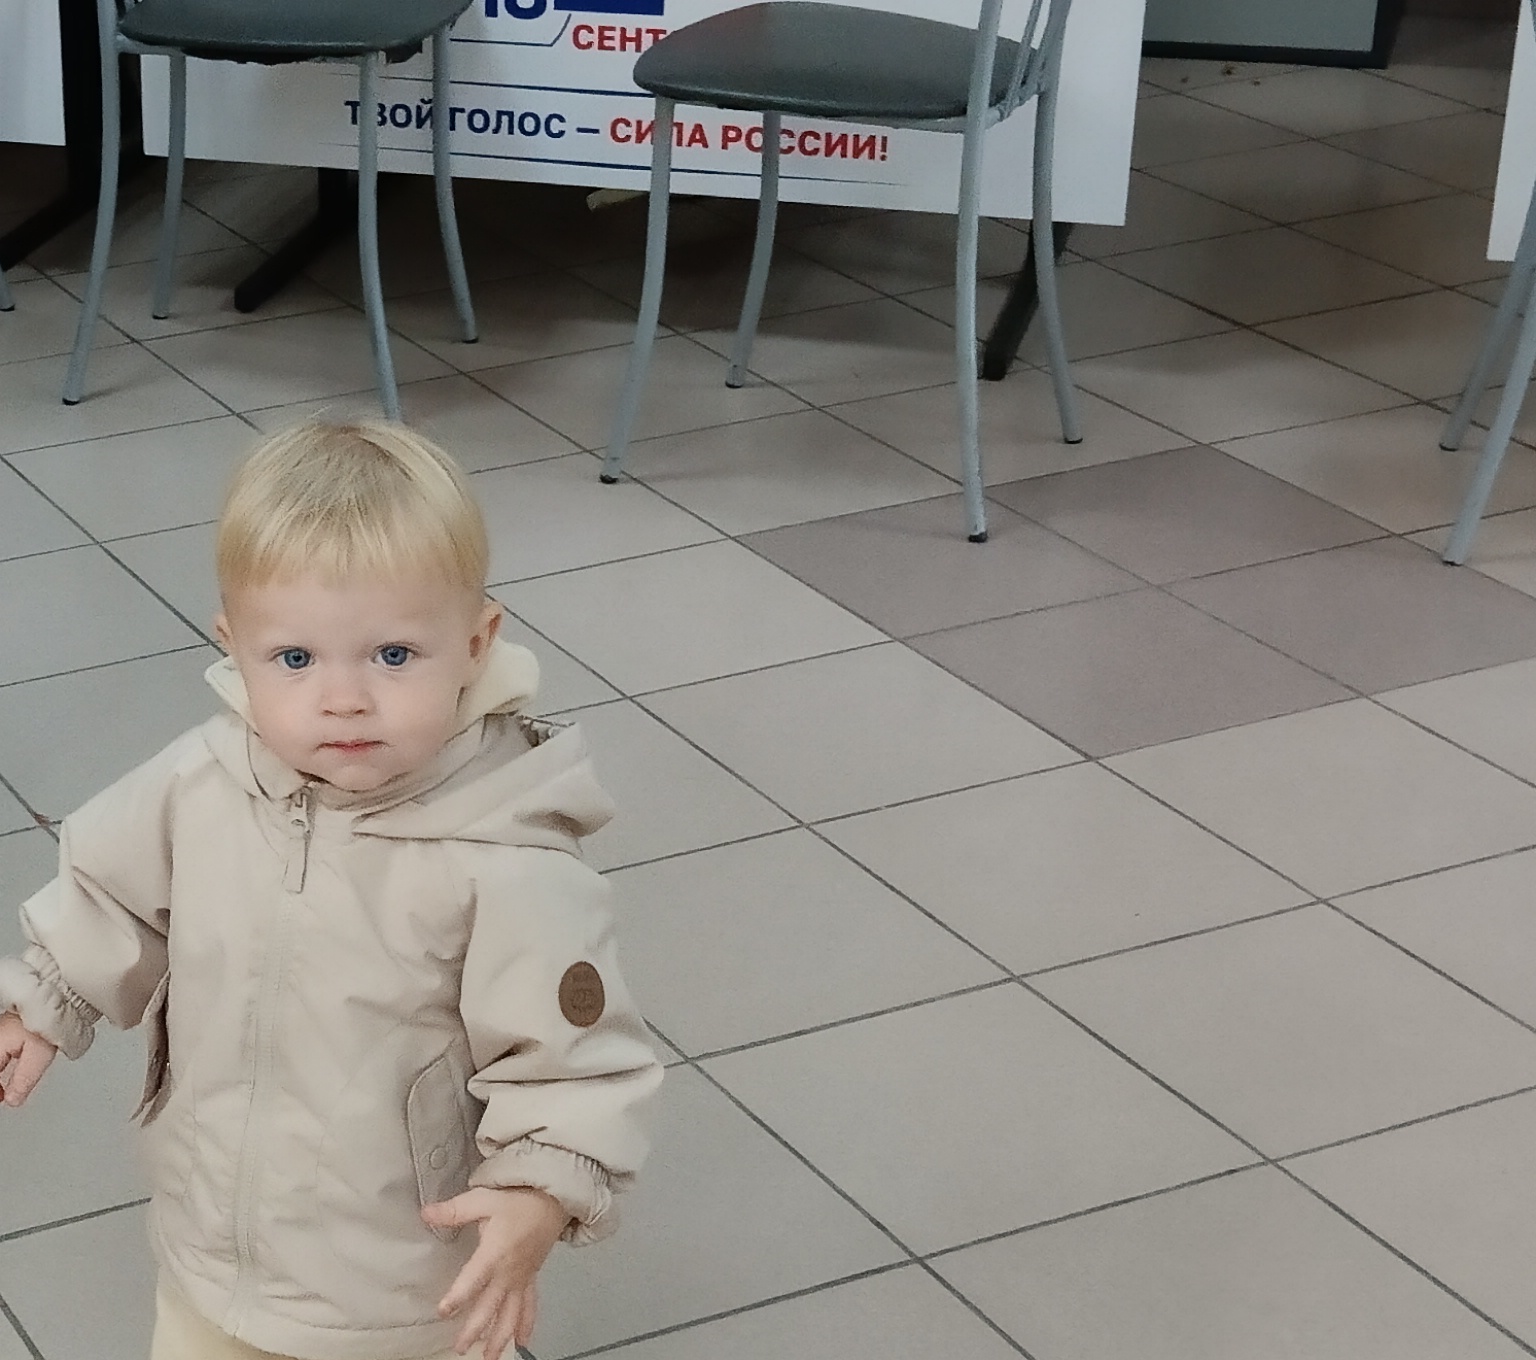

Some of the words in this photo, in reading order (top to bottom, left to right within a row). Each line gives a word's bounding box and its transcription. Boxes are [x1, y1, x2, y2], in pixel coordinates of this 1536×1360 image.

[571, 24, 667, 54] СЕНТ
[448, 106, 566, 139] ГОЛОС
[721, 124, 889, 162] РОССИИ!
